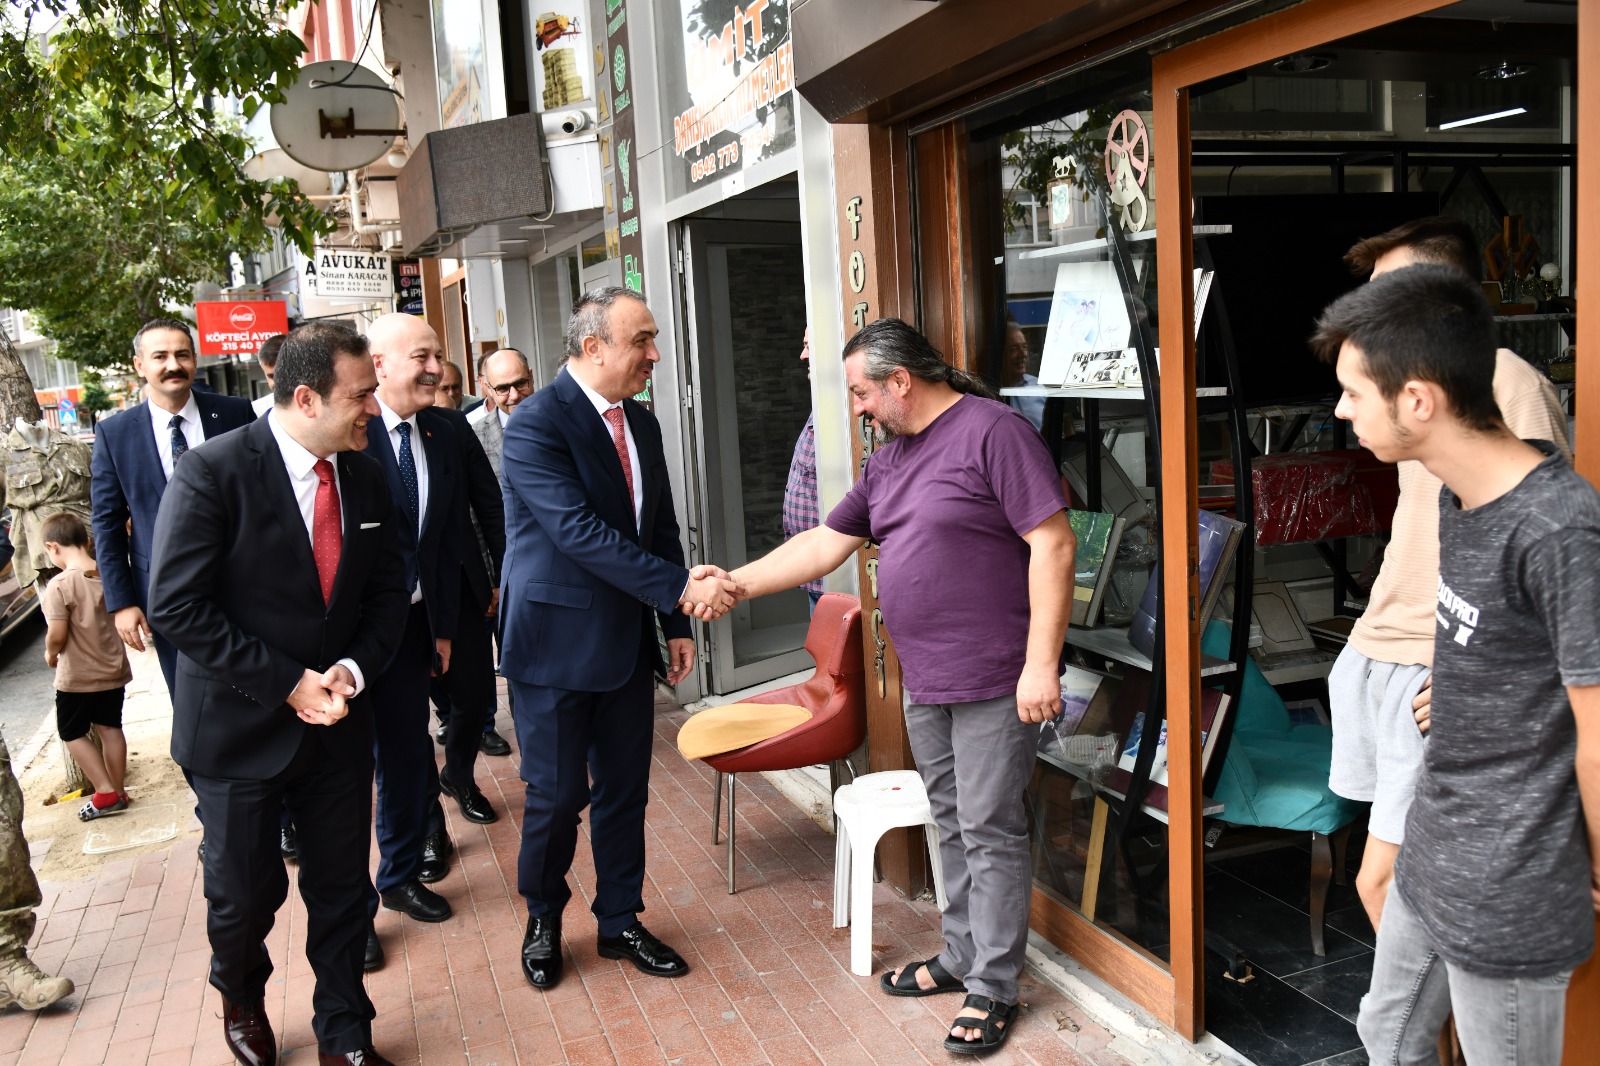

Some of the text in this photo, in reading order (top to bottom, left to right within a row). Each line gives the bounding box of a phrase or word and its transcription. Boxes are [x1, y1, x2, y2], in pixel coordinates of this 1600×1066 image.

[691, 152, 716, 182] 0542
[717, 141, 739, 171] 773
[321, 254, 387, 270] AVUKAT
[320, 271, 388, 281] Sinan KARACAK
[205, 330, 250, 342] KÖFTECİ
[221, 342, 238, 351] 315
[240, 342, 253, 350] 40
